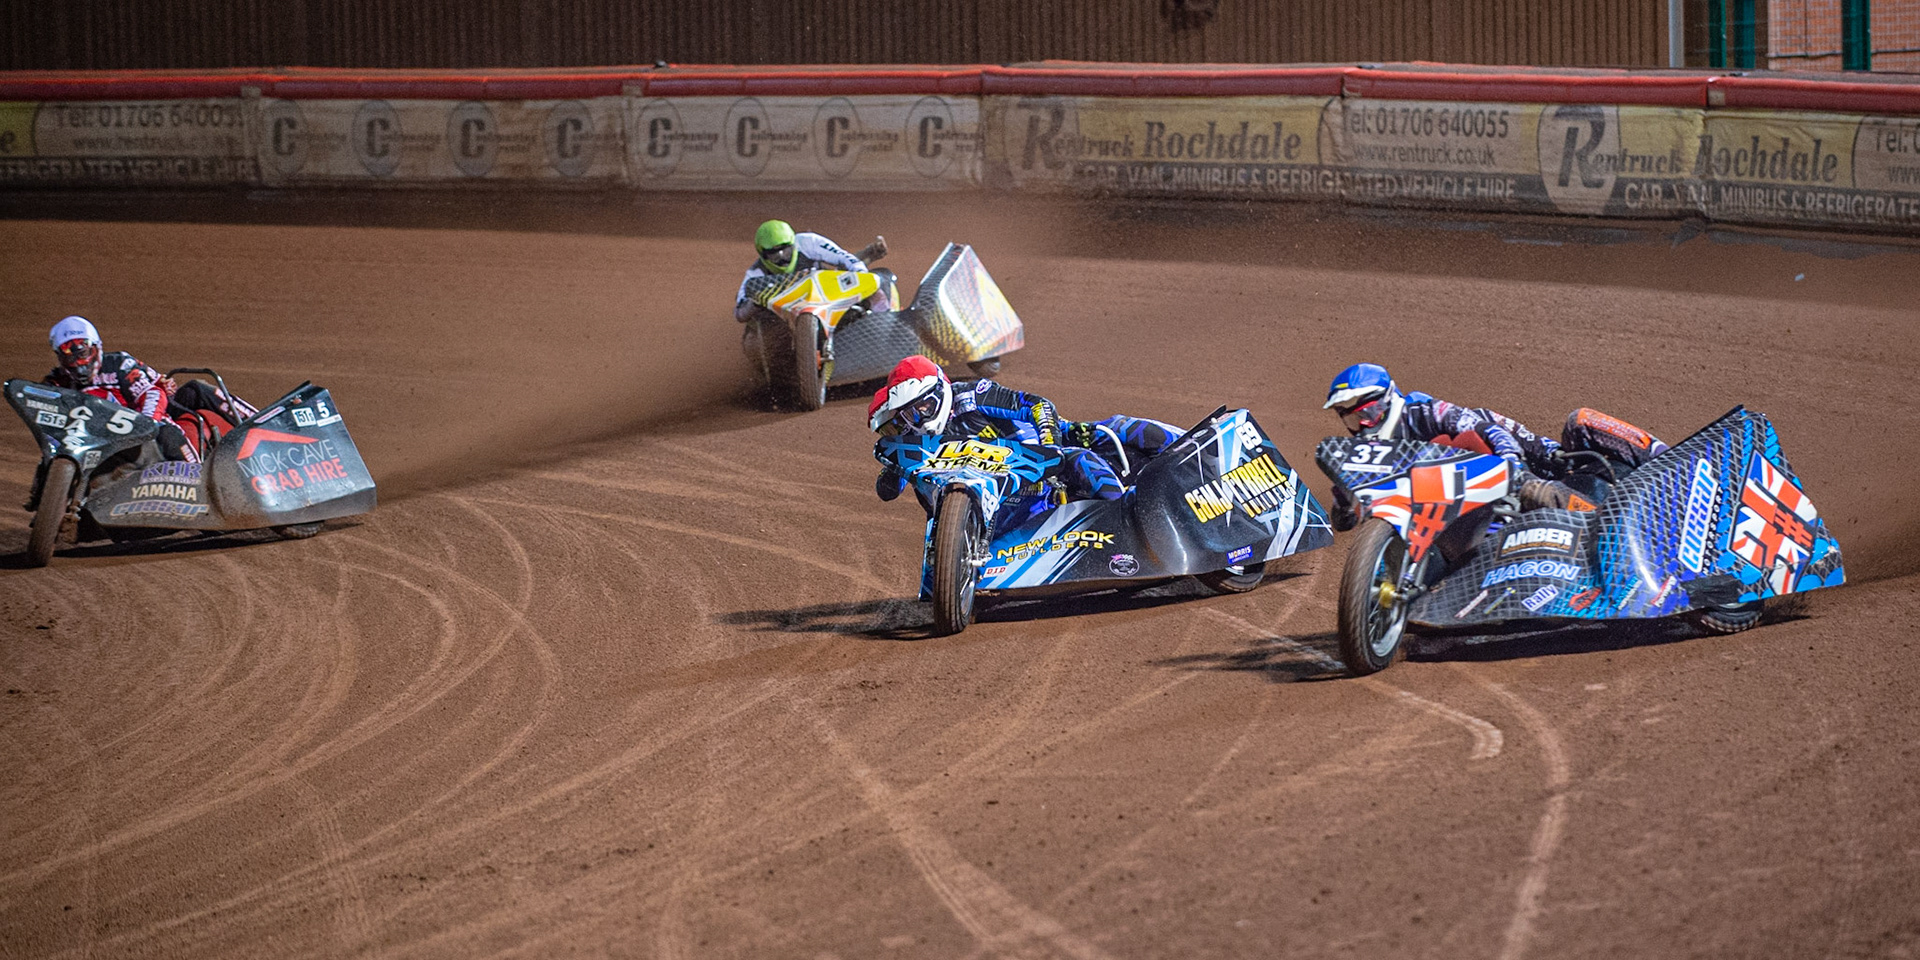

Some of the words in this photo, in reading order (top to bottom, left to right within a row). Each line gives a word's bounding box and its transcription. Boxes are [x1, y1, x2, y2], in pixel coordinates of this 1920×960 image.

[1375, 107, 1433, 133] 01706
[1438, 110, 1510, 138] 640055
[1143, 120, 1301, 161] Rochdale
[1352, 142, 1497, 167] www.rentruck.co.uk
[1173, 166, 1248, 190] MINIBUS
[1402, 175, 1474, 199] VEHICLE
[1476, 177, 1516, 201] HIRE
[1720, 186, 1787, 211] MINIBUS
[317, 401, 330, 418] 5
[106, 410, 137, 435] 5
[1235, 421, 1263, 451] 69
[237, 449, 289, 478] MICK
[288, 439, 338, 468] CAVE
[926, 457, 1011, 474] XTREME
[1350, 444, 1392, 465] 37
[141, 461, 202, 479] KHR
[252, 468, 305, 495] GRAB
[303, 457, 348, 484] HIRE
[1220, 453, 1288, 505] TYRRELL
[132, 484, 197, 500] YAMAHA
[1241, 480, 1298, 518] BUILDERS
[997, 537, 1048, 560] NEW
[1052, 530, 1115, 547] LOOK
[1502, 527, 1574, 550] AMBER
[1005, 541, 1104, 564] BUILDERS
[1228, 546, 1251, 560] MORRIS
[1481, 560, 1582, 588] HAGON
[1523, 585, 1557, 610] Rally
